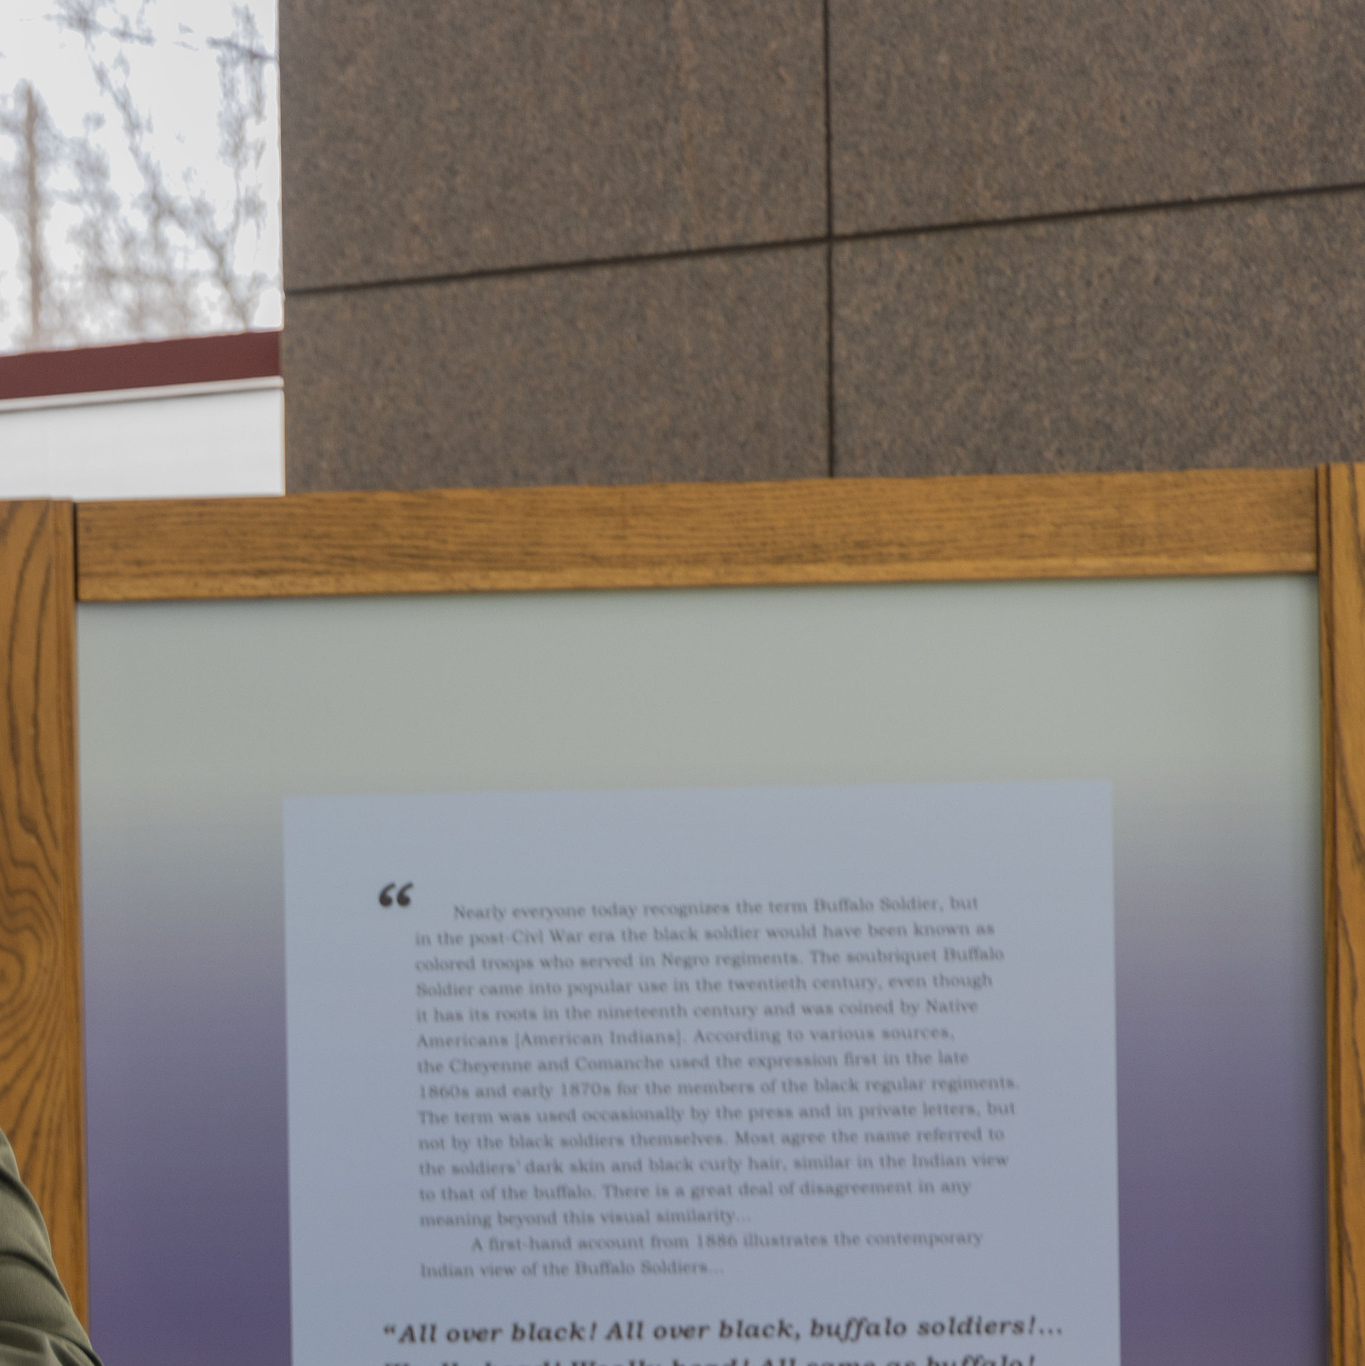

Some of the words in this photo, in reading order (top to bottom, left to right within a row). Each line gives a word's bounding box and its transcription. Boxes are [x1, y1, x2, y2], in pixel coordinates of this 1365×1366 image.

[453, 904, 507, 923] Nearly
[512, 907, 586, 922] everyone
[591, 902, 637, 920] today
[643, 902, 730, 920] recognizes
[736, 900, 763, 915] the
[768, 901, 808, 914] term
[813, 897, 874, 913] Buffalo
[879, 896, 944, 912] Soldier,
[949, 895, 978, 910] but
[437, 931, 464, 945] the
[549, 928, 583, 943] War
[588, 931, 615, 943] era
[621, 927, 647, 942] the
[653, 927, 698, 942] black
[704, 926, 760, 941] soldier
[765, 925, 817, 940] would
[822, 924, 862, 939] have
[867, 923, 907, 938] been
[913, 921, 970, 937] known
[975, 924, 995, 936] as
[414, 957, 476, 972] colored
[481, 958, 534, 975] troops
[539, 954, 574, 969] who
[579, 953, 633, 968] served
[661, 952, 710, 970] Negro
[809, 949, 840, 965] The
[846, 948, 937, 967] soubriquet
[943, 946, 1004, 961] Buffalo
[416, 982, 473, 997] Soldier
[479, 984, 523, 996] came
[529, 982, 562, 996] into
[567, 979, 632, 999] popular
[638, 982, 668, 993] use
[695, 977, 722, 992] the
[728, 975, 807, 991] twentieth
[812, 976, 883, 993] century,
[888, 977, 927, 988] even
[932, 972, 993, 991] though
[417, 1033, 509, 1048] Americans
[694, 1028, 782, 1046] According
[787, 1029, 804, 1041] to
[810, 1028, 875, 1041] various
[882, 1028, 955, 1041] sources,
[420, 1084, 470, 1099] 1860s
[475, 1084, 507, 1099] and
[512, 1082, 553, 1101] early
[561, 1082, 611, 1097] 1870s
[616, 1081, 639, 1096] for
[645, 1081, 671, 1096] the
[677, 1080, 755, 1095] members
[760, 1078, 777, 1093] of
[781, 1078, 808, 1093] the
[813, 1077, 859, 1092] black
[865, 1076, 925, 1094] regular
[419, 1213, 492, 1231] meaning
[497, 1210, 557, 1229] beyond
[563, 1210, 595, 1225] this
[600, 1209, 650, 1224] visual
[421, 1263, 475, 1278] Indian
[480, 1264, 517, 1277] view
[521, 1262, 538, 1277] of
[542, 1261, 569, 1276] the
[575, 1260, 635, 1276] Buffalo
[445, 1328, 502, 1343] over
[511, 1321, 597, 1342] black!
[605, 1321, 643, 1341] All
[652, 1325, 710, 1340] over
[718, 1319, 801, 1342] black,
[809, 1317, 907, 1343] buffalo
